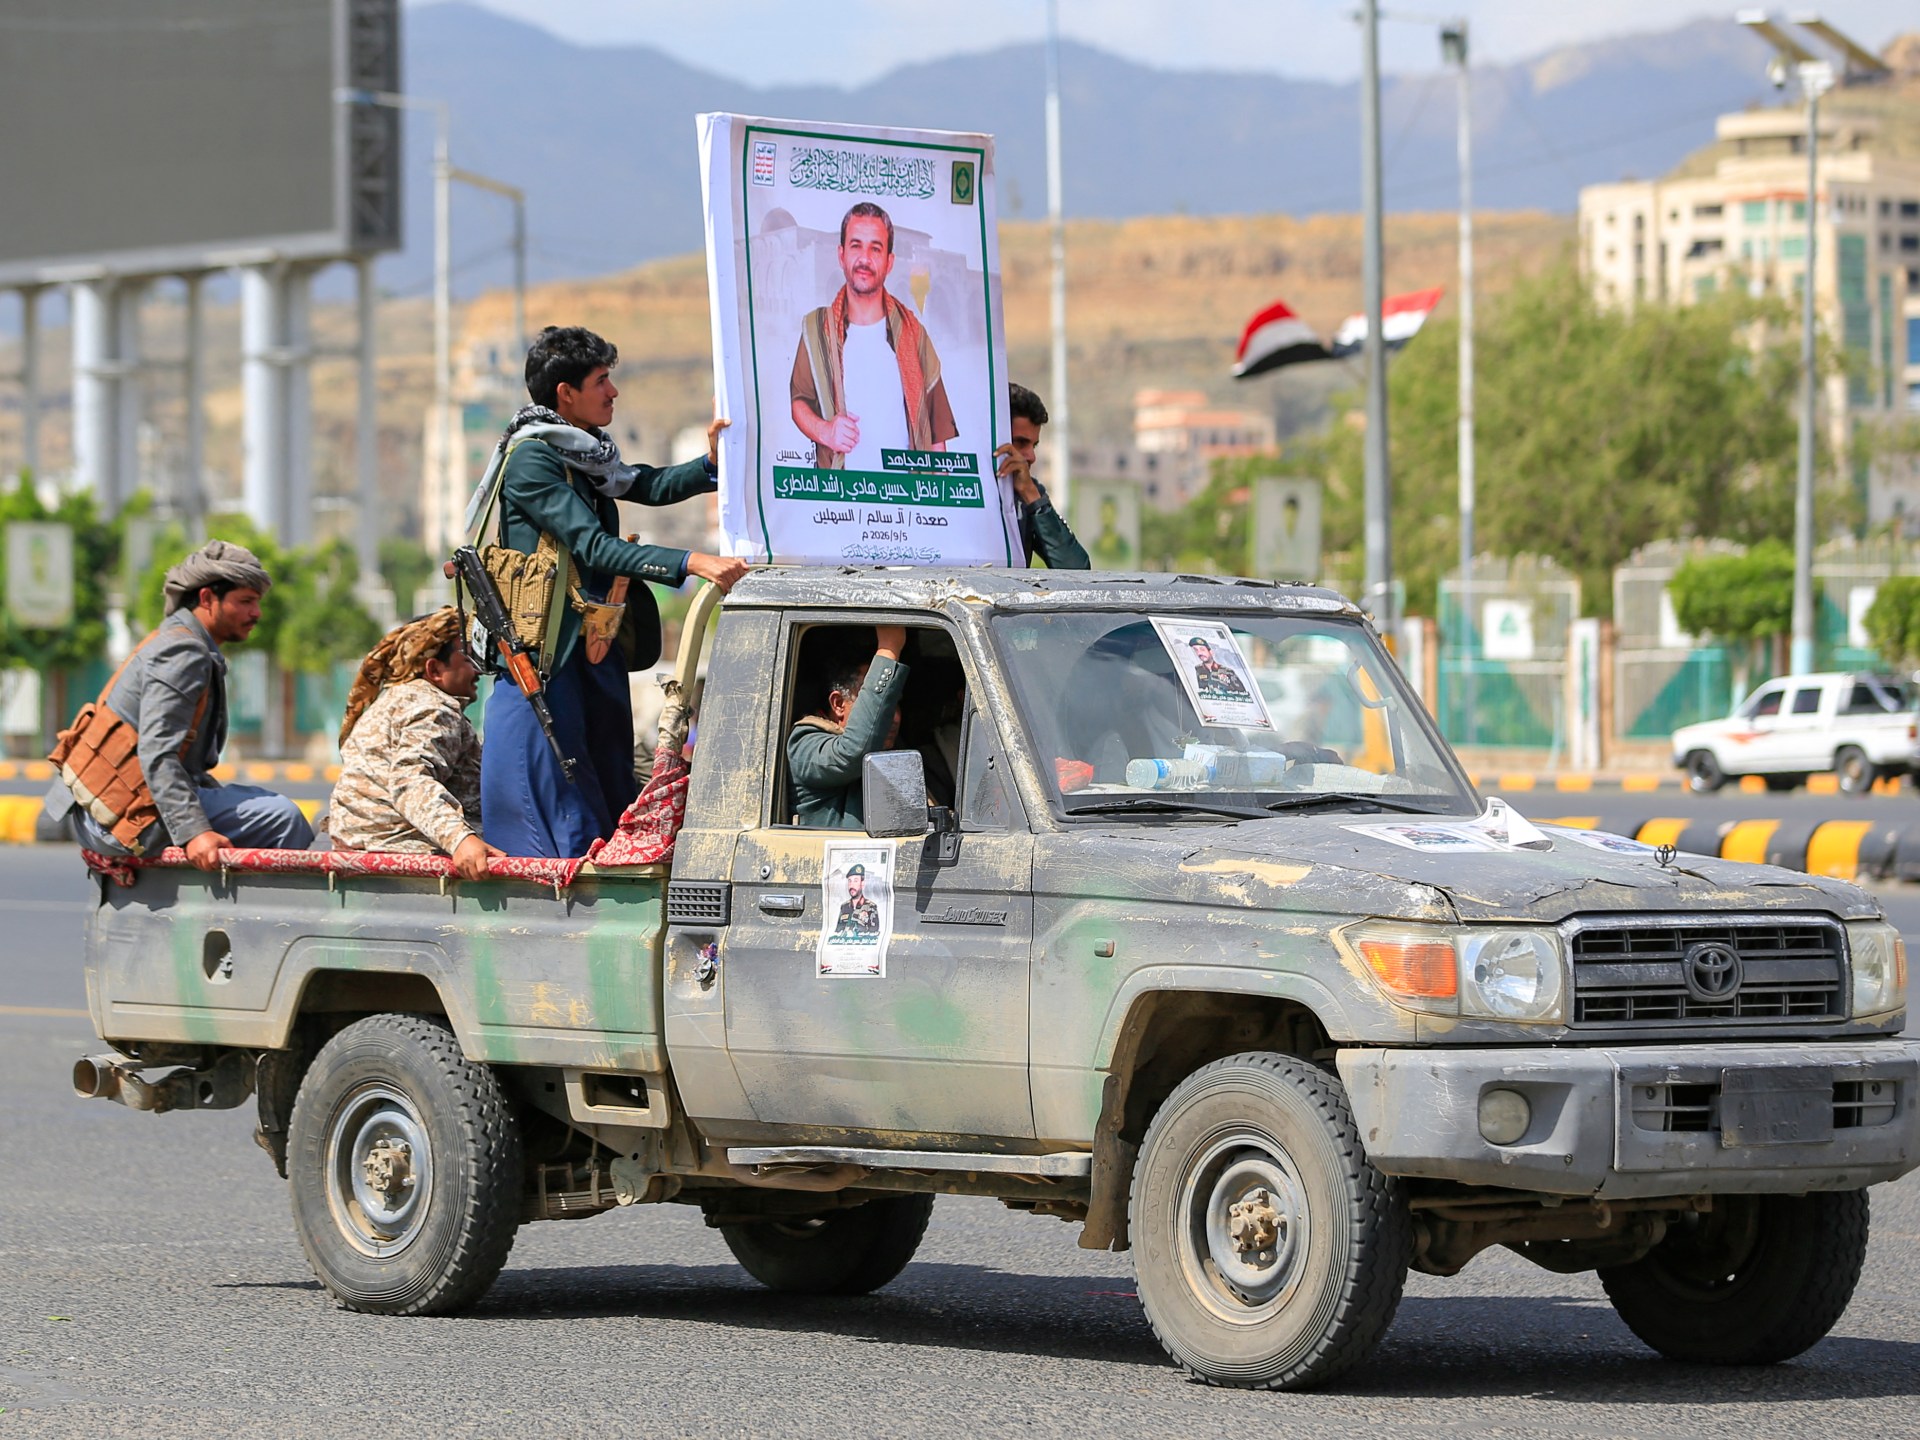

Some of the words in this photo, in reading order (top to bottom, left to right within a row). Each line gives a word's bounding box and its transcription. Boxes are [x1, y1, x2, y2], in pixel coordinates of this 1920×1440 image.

[776, 449, 802, 462] حسين
[804, 443, 816, 464] أبو
[887, 452, 931, 471] المجاهد
[934, 453, 971, 472] الشهيد
[776, 473, 820, 498] الماطري
[822, 473, 845, 499] راشد
[846, 477, 877, 501] هادي
[879, 482, 909, 501] حسين
[949, 482, 981, 504] العقيد
[813, 508, 855, 525] السهلين
[867, 510, 893, 526] سالم
[915, 512, 948, 527] صعدة
